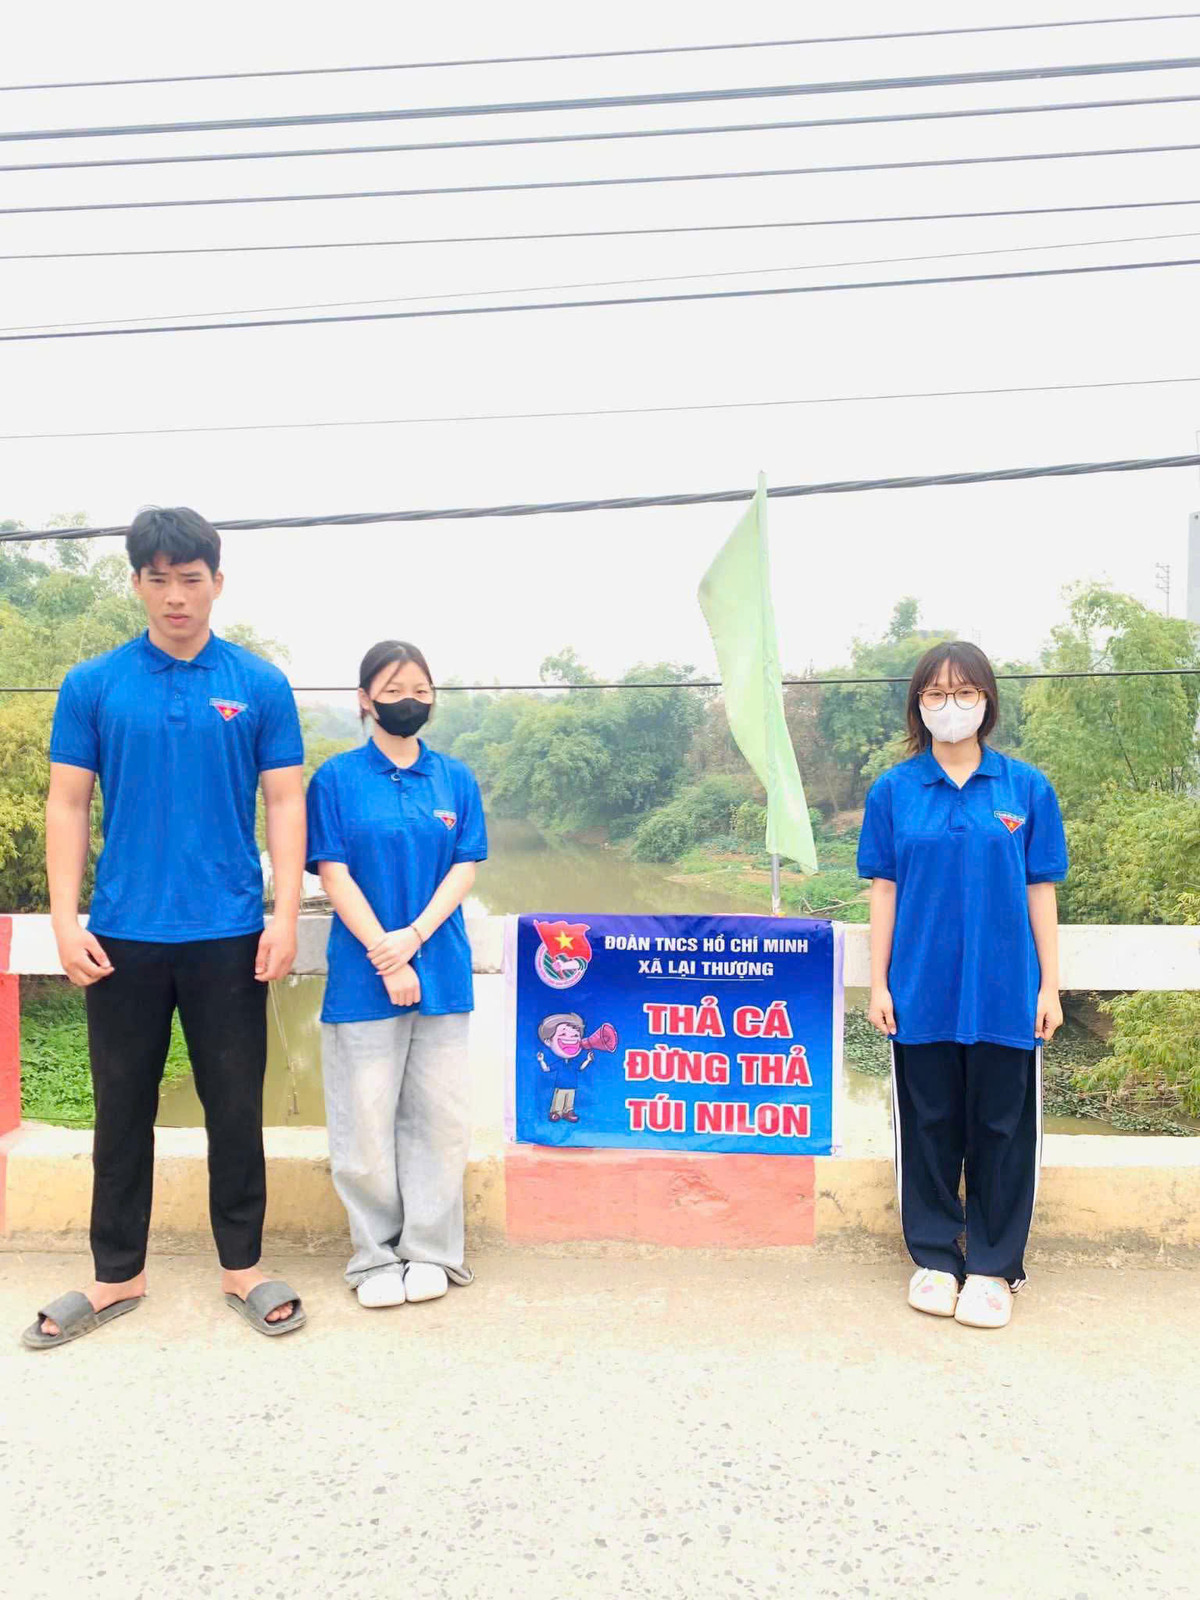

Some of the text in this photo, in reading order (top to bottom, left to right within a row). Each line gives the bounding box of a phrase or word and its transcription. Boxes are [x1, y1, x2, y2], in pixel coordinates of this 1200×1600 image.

[604, 933, 650, 951] ĐOÀN
[655, 936, 698, 952] TNCS
[730, 935, 758, 953] CHÍ
[763, 938, 808, 953] MINH
[638, 957, 774, 979] XÃ LẠI THƯỢNG
[644, 995, 793, 1038] THẢ CÁ
[624, 1044, 812, 1086] ĐỪNG THẢ
[626, 1094, 811, 1137] TÚI NILON
